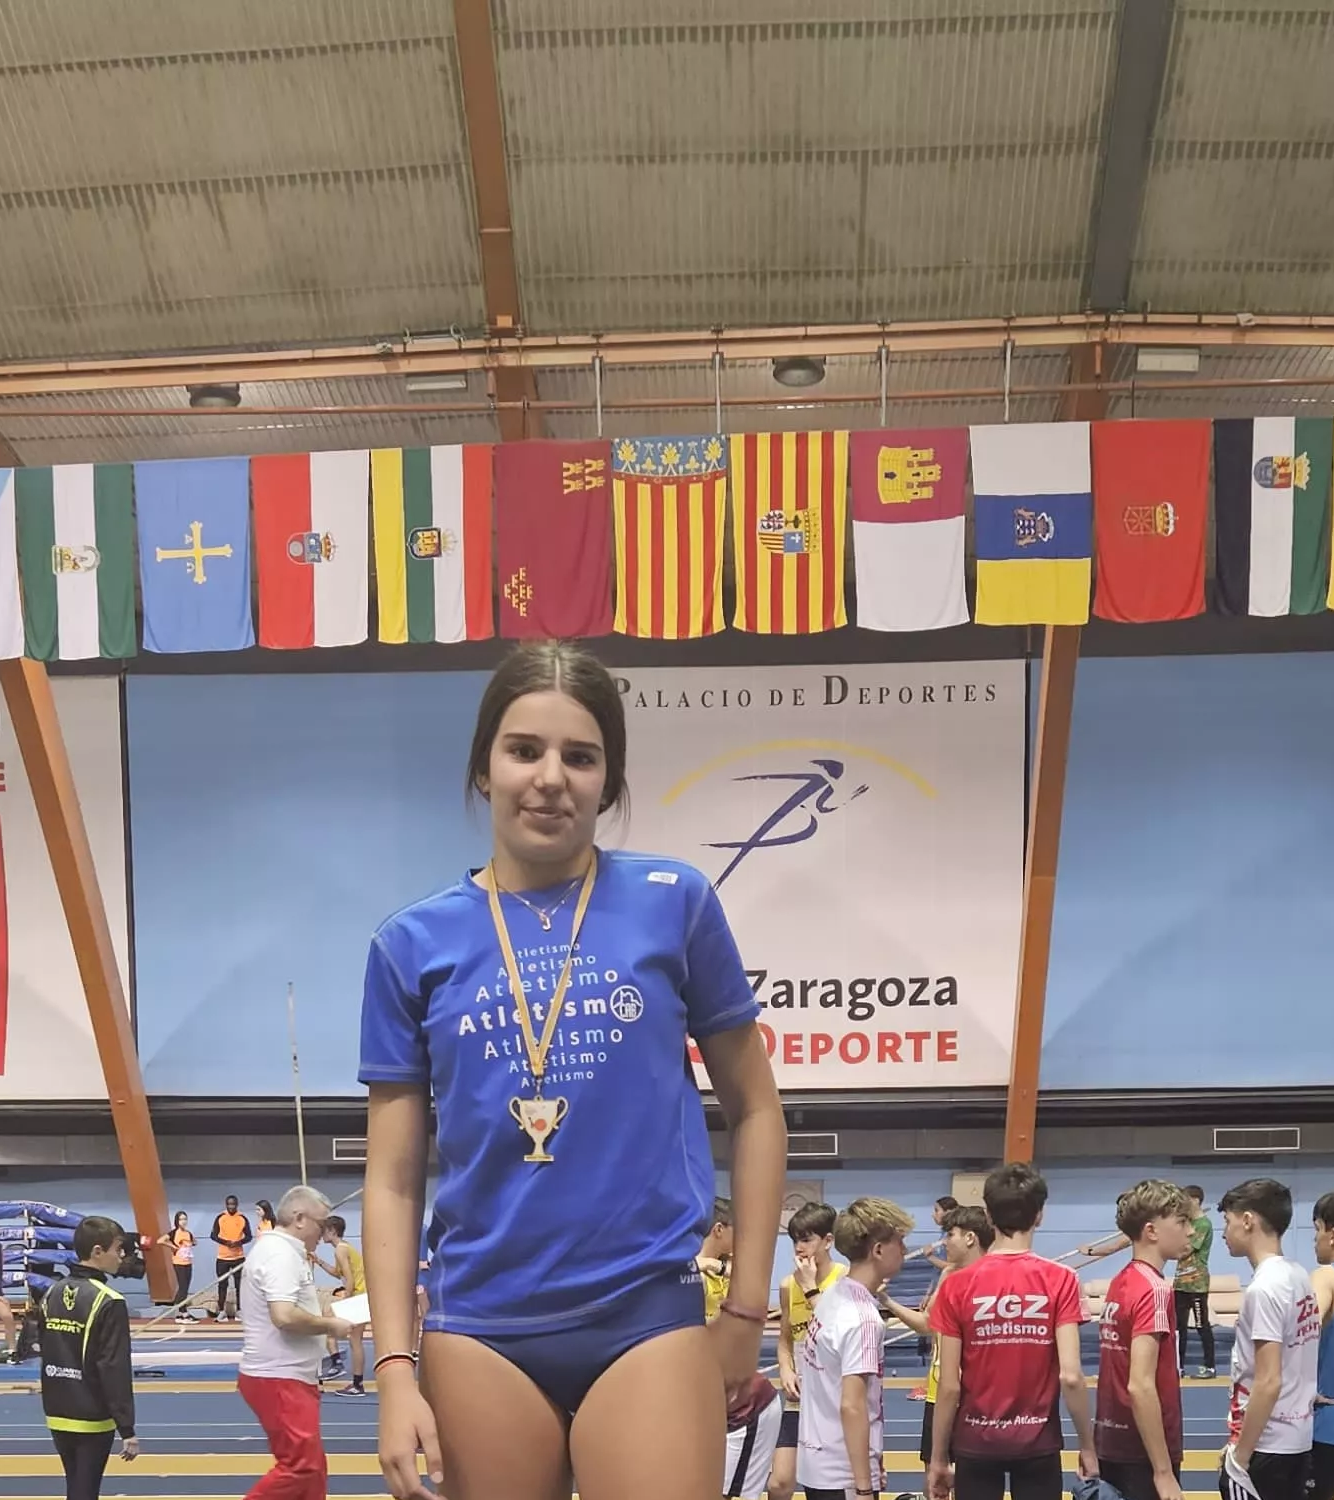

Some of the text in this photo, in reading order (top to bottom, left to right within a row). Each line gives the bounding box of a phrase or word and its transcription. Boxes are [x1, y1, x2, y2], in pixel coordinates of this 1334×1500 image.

[768, 689, 806, 706] DE
[822, 675, 997, 706] DEPORTES
[517, 943, 581, 959] tletismo
[497, 954, 596, 980] Aletismo
[744, 969, 959, 1022] Zaragoza
[484, 1027, 623, 1060] Atlismo
[509, 1051, 607, 1074] Atetismo
[972, 1294, 1050, 1322] ZGZ
[976, 1320, 1048, 1337] atletismo
